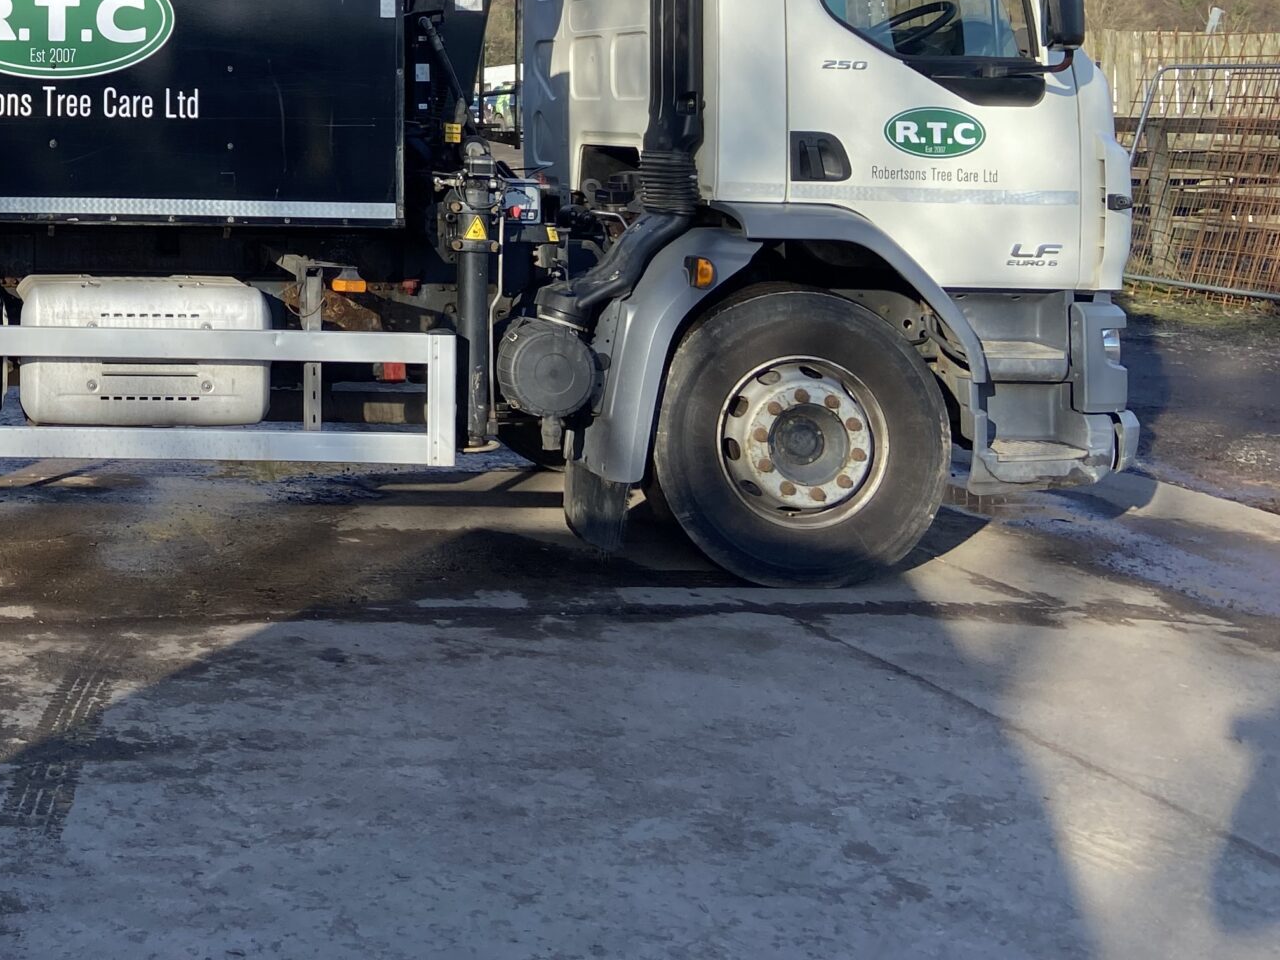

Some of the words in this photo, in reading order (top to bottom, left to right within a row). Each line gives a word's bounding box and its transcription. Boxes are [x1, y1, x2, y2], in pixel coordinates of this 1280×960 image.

[29, 47, 46, 64] Est
[49, 47, 77, 64] 2007
[821, 59, 868, 71] 250
[42, 85, 92, 118] Tree
[103, 86, 154, 119] Care
[165, 87, 199, 119] Ltd
[894, 120, 977, 146] R.T.C
[871, 165, 927, 182] Robertsons
[930, 167, 953, 182] Tree
[956, 168, 979, 183] Care
[983, 169, 998, 183] Ltd
[1010, 243, 1063, 258] LF
[1006, 259, 1045, 267] EURO
